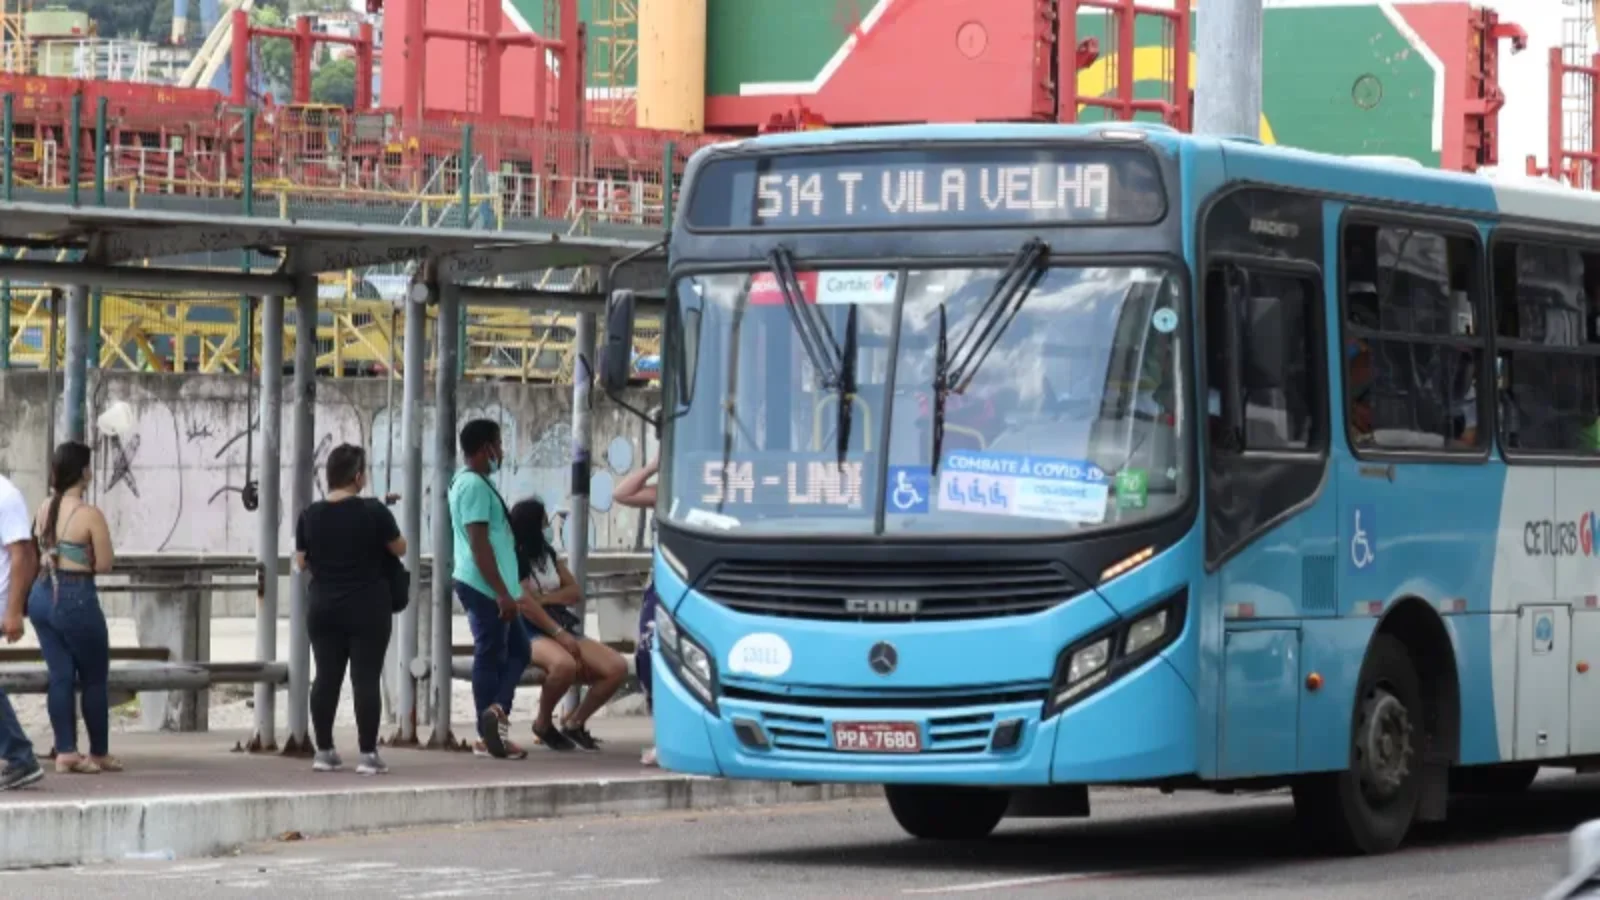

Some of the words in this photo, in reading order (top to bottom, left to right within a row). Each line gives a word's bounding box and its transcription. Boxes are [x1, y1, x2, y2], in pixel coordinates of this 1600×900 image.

[757, 173, 824, 217] 514
[837, 172, 868, 216] T.
[881, 168, 965, 213] VILA
[980, 164, 1109, 213] VELHA
[827, 275, 873, 293] Cartão
[701, 461, 755, 503] 514
[948, 455, 1018, 473] COMBATE
[1034, 462, 1105, 480] COVID-19
[1523, 520, 1578, 556] CETURB
